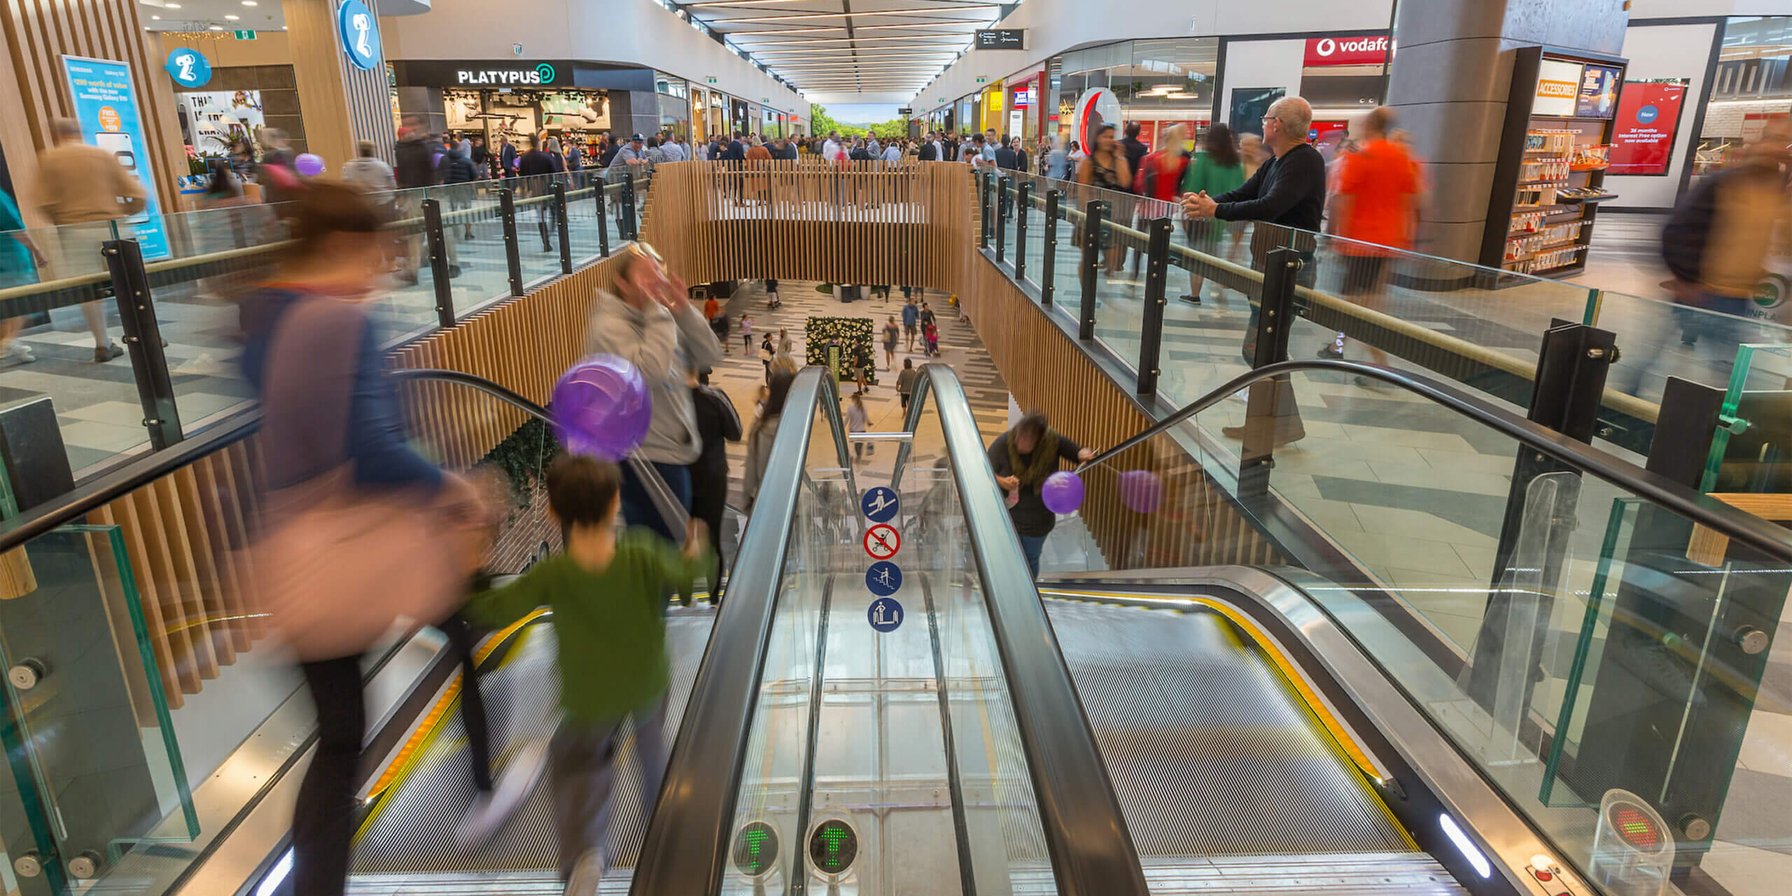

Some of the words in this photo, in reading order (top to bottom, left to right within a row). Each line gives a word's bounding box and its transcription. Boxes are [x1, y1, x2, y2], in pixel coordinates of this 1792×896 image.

[457, 71, 540, 84] PLATYPUS
[1539, 83, 1575, 97] ACCESSORIES
[191, 96, 212, 108] THI
